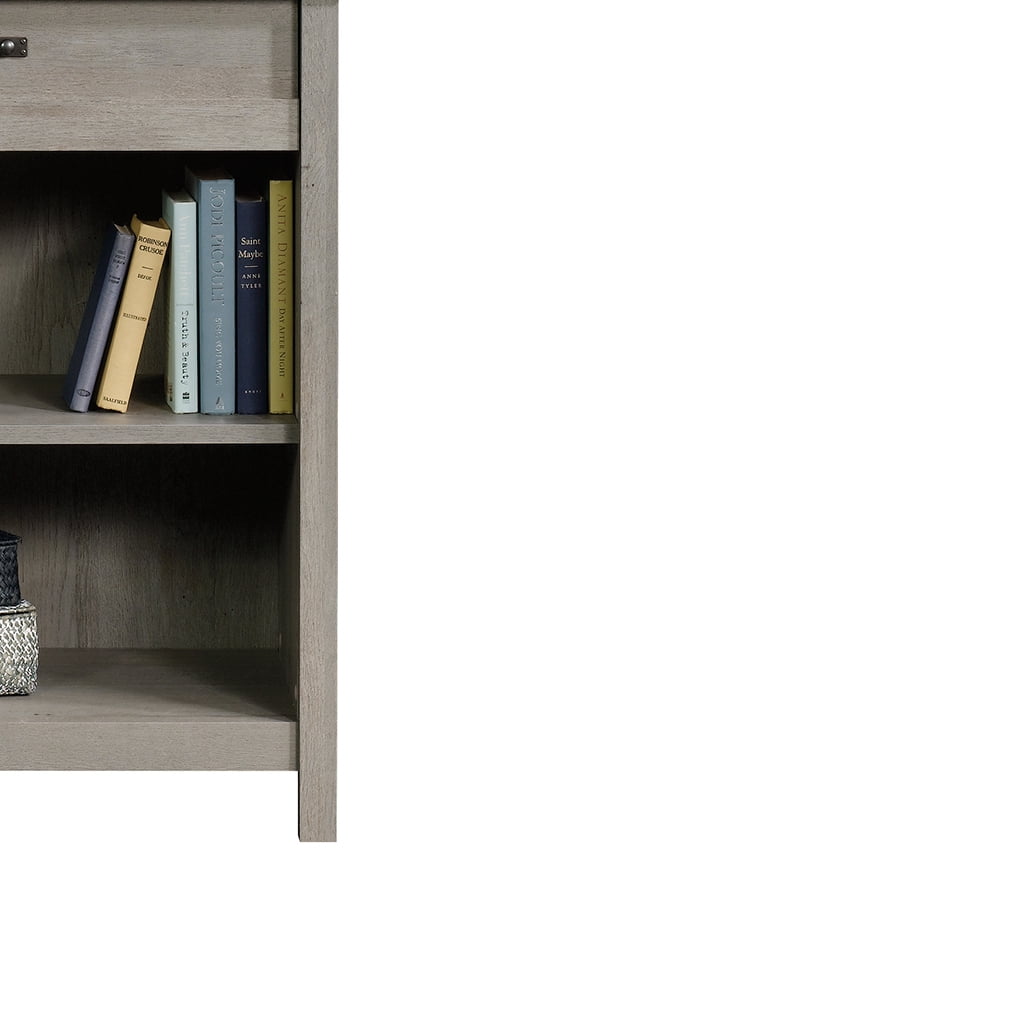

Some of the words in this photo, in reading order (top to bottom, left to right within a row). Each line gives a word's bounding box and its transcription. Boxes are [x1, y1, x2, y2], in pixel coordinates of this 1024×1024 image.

[209, 186, 226, 226] JODI
[277, 193, 288, 235] ANITA
[137, 235, 168, 248] ROBINSON
[139, 244, 164, 256] CRUSOE
[238, 249, 264, 260] Maybe
[240, 236, 262, 246] Saint
[211, 234, 225, 307] PICOULT
[277, 241, 288, 305] DIAMANT
[181, 309, 190, 340] Truth
[180, 351, 190, 386] Beauty
